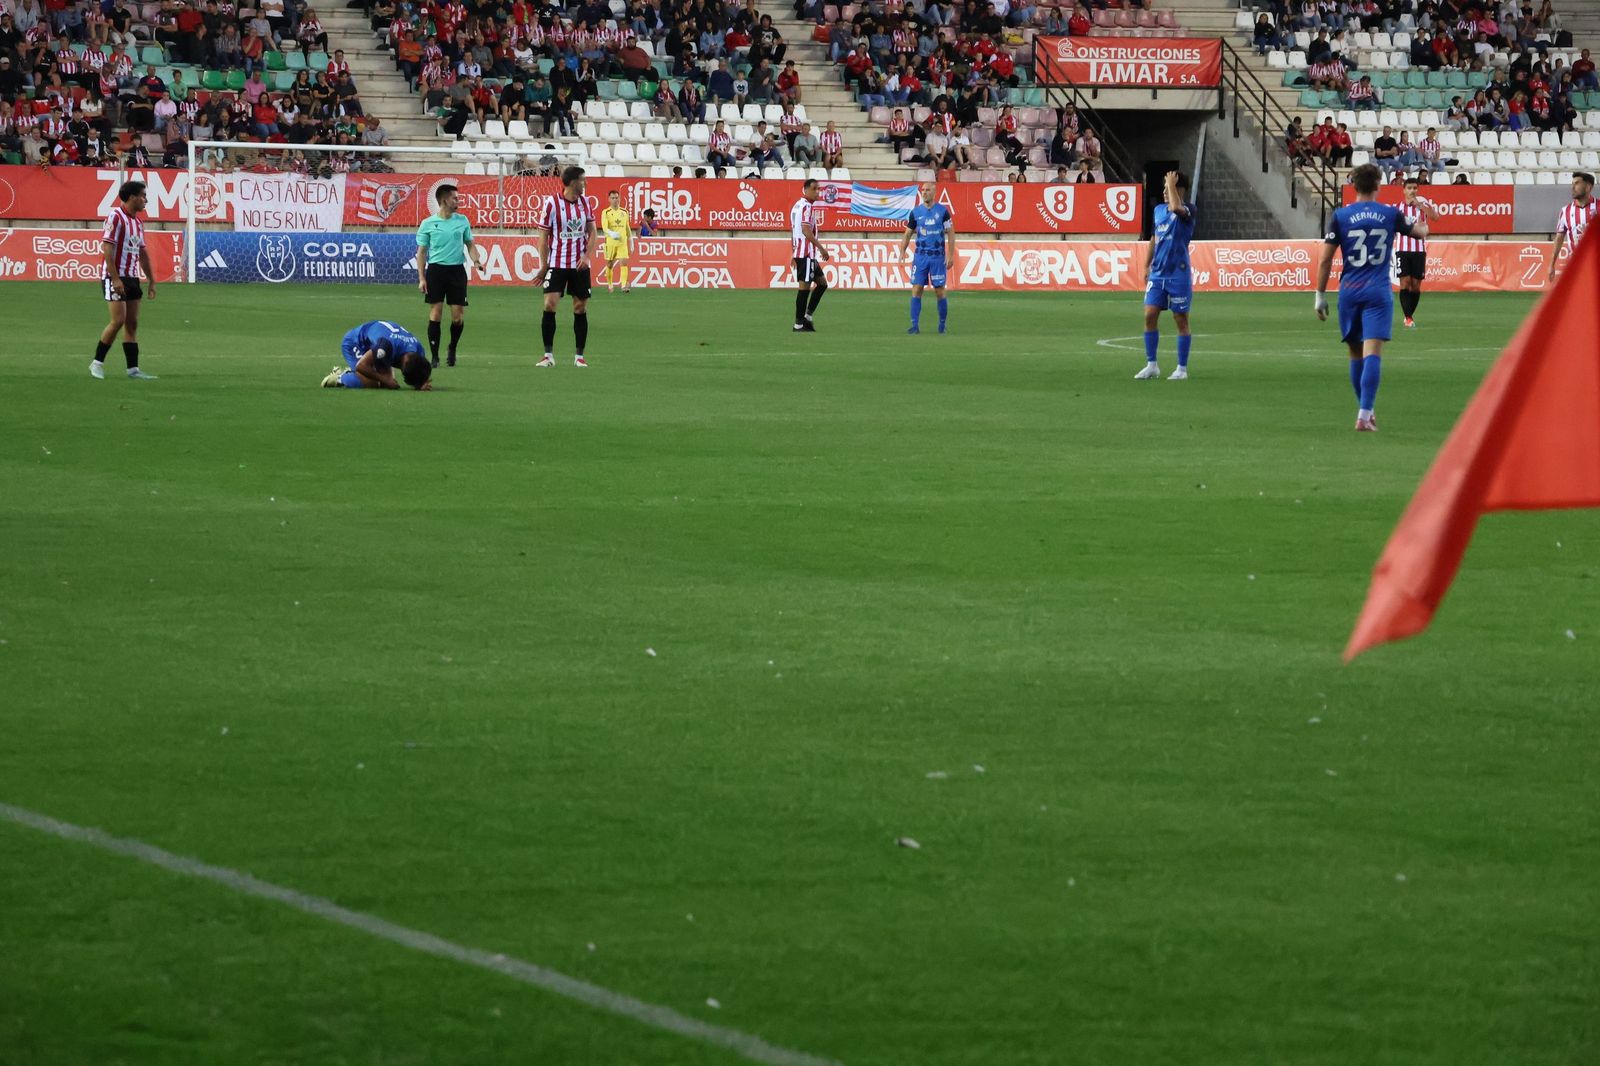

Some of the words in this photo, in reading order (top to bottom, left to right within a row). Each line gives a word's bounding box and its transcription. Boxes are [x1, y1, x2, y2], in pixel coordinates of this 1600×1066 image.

[1090, 60, 1174, 84] TAMAR,
[1180, 74, 1200, 84] S.A.
[240, 178, 338, 204] CASTAÑEDA
[634, 182, 692, 209] fisio
[992, 189, 1006, 215] 8
[1053, 190, 1068, 215] 8
[1115, 190, 1130, 215] 8
[709, 207, 784, 226] podoactiva
[974, 201, 998, 230] ZAMORA
[1035, 202, 1059, 231] ZAMORA
[1098, 202, 1121, 231] ZAMORA
[1350, 211, 1387, 224] HERNAIZ
[33, 235, 105, 255] Escu
[303, 242, 374, 257] COPA
[1215, 246, 1311, 265] Escuela
[1347, 228, 1389, 268] 33
[304, 259, 375, 278] FEDERACIÓN
[630, 266, 736, 288] ZAMORA
[769, 266, 915, 289] ZAORANAS
[958, 249, 1087, 285] ZAMORA
[1088, 250, 1132, 285] CF
[1218, 268, 1312, 288] infantil
[1426, 267, 1458, 276] AMORA
